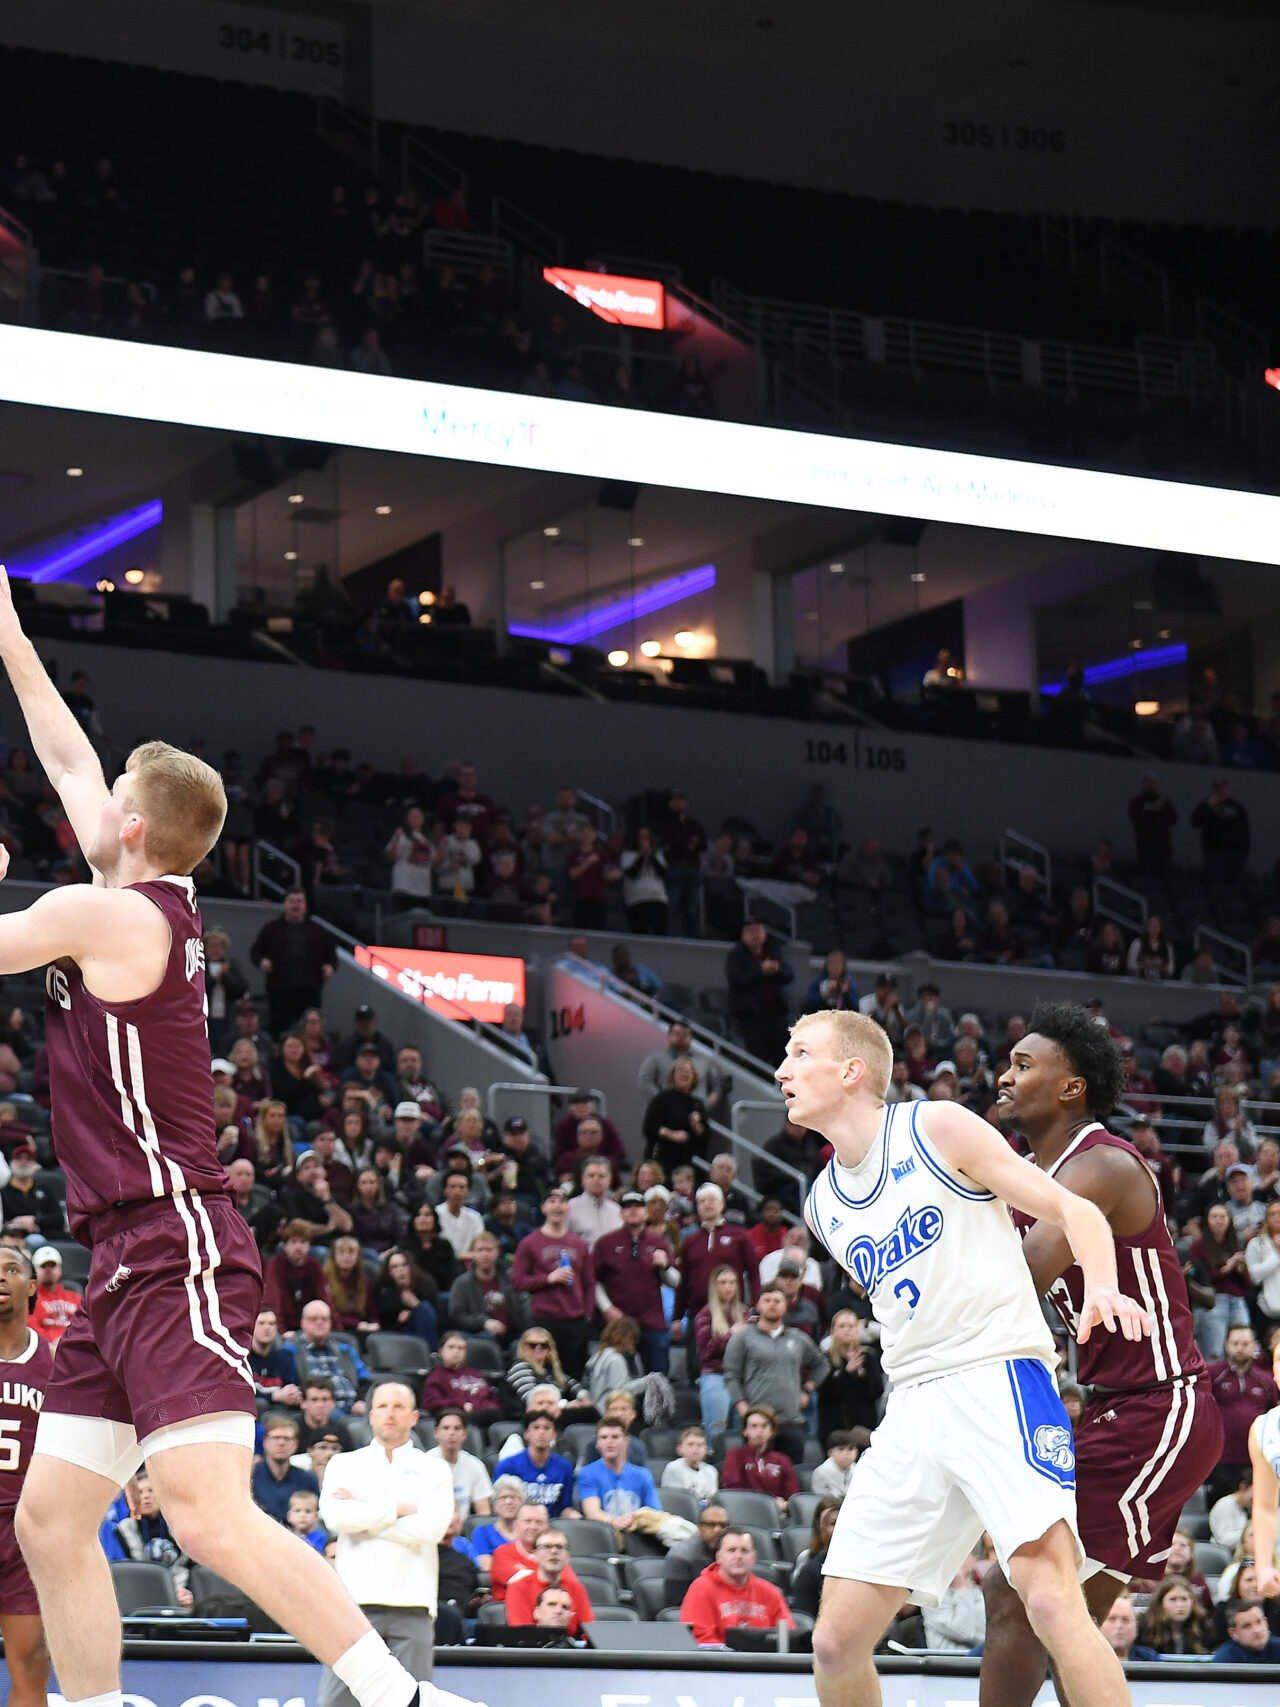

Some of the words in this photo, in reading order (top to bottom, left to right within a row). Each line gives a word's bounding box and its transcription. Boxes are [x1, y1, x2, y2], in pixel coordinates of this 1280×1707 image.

[218, 23, 270, 54] 304
[804, 739, 846, 764] 104
[864, 744, 906, 771] 105
[549, 1004, 585, 1039] 104
[847, 1206, 942, 1294] Drake
